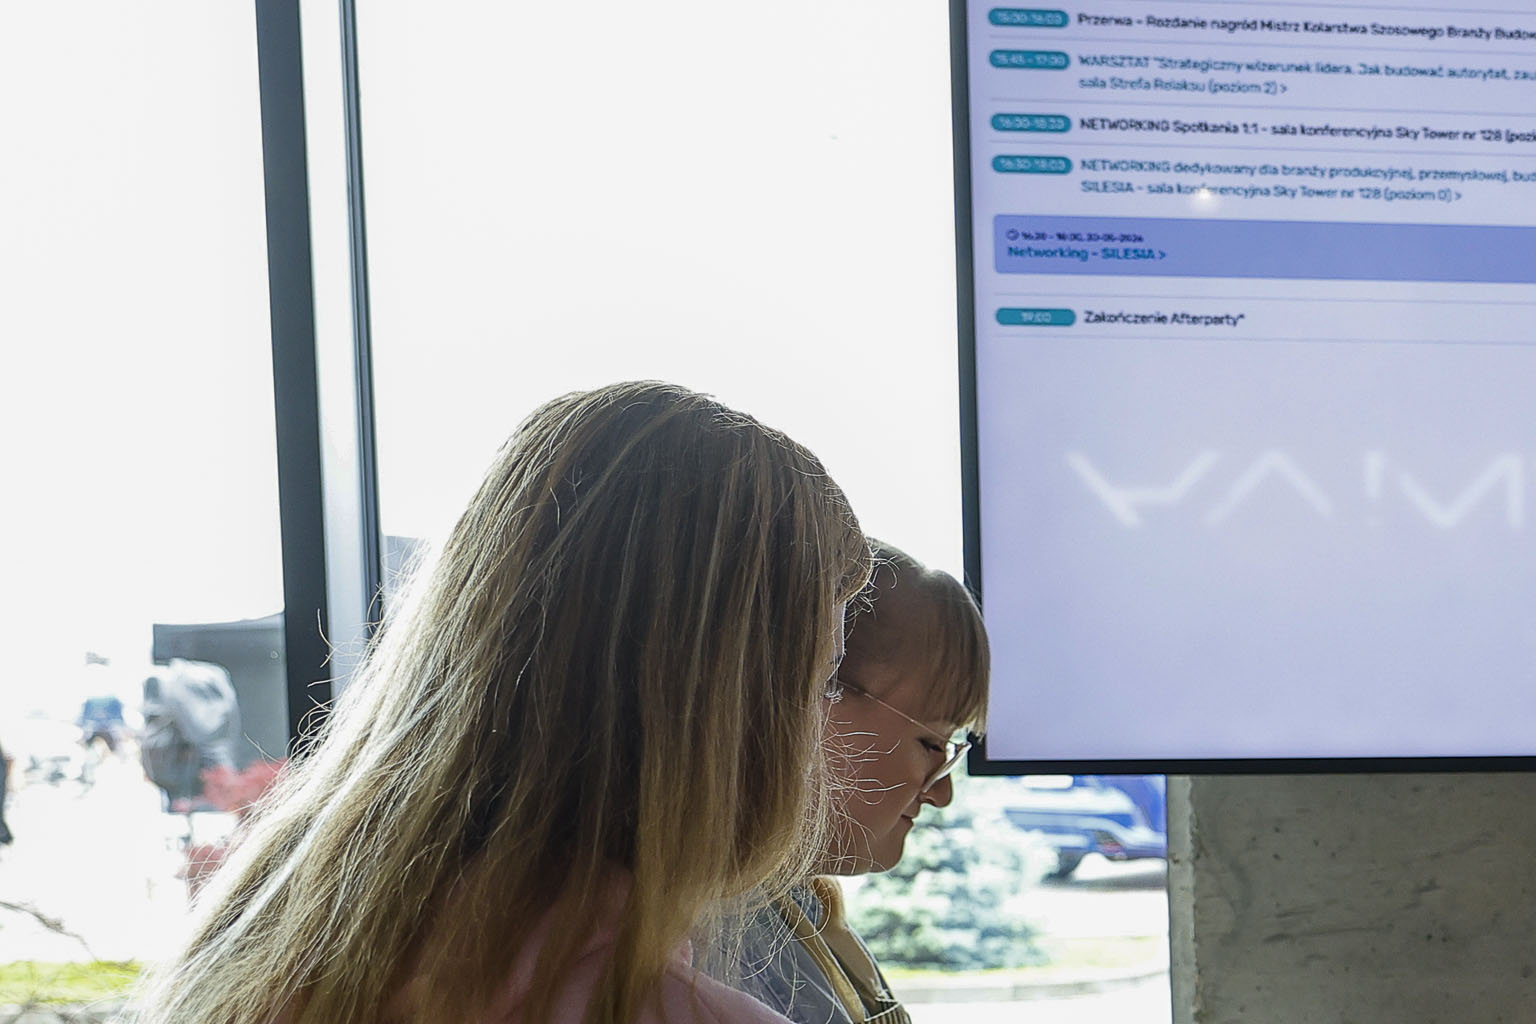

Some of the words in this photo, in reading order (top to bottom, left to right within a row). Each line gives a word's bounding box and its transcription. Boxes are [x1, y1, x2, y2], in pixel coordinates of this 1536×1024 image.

[1077, 13, 1133, 26] Przerwa
[1146, 15, 1207, 29] Rozdanie
[1210, 19, 1258, 33] nagród
[1260, 20, 1300, 32] Mistrz
[1303, 21, 1367, 34] Kolarstwa
[1371, 24, 1444, 40] Szosowego
[1447, 26, 1492, 40] Branży
[1078, 55, 1150, 68] WARSZTAT
[1246, 61, 1311, 73] wizerunek
[1358, 63, 1380, 75] Jak
[1384, 65, 1444, 77] budować
[1079, 77, 1106, 89] sala
[1110, 76, 1150, 90] Strefa
[1154, 78, 1205, 92] Relaksu
[1208, 79, 1261, 94] (poziom
[1080, 117, 1170, 132] NETWORKING
[1173, 121, 1239, 134] Spotkania
[1271, 124, 1297, 136] sala
[1300, 124, 1393, 140] konferencyjna
[1396, 126, 1419, 141] Sky
[1422, 127, 1460, 140] Tower
[1081, 158, 1170, 172] NETWORKING
[1174, 162, 1256, 176] dedykowany
[1259, 164, 1279, 175] dla
[1282, 165, 1326, 178] branży
[1081, 180, 1134, 193] SILESIA
[1147, 183, 1174, 194] sala
[1177, 182, 1270, 199] konferencyjna
[1273, 186, 1297, 199] Sky
[1300, 185, 1338, 198] Tower
[1384, 187, 1435, 201] (poziom
[1008, 246, 1088, 261] Networking
[1101, 248, 1155, 260] SILESIA
[1084, 310, 1168, 324] Zakończenie
